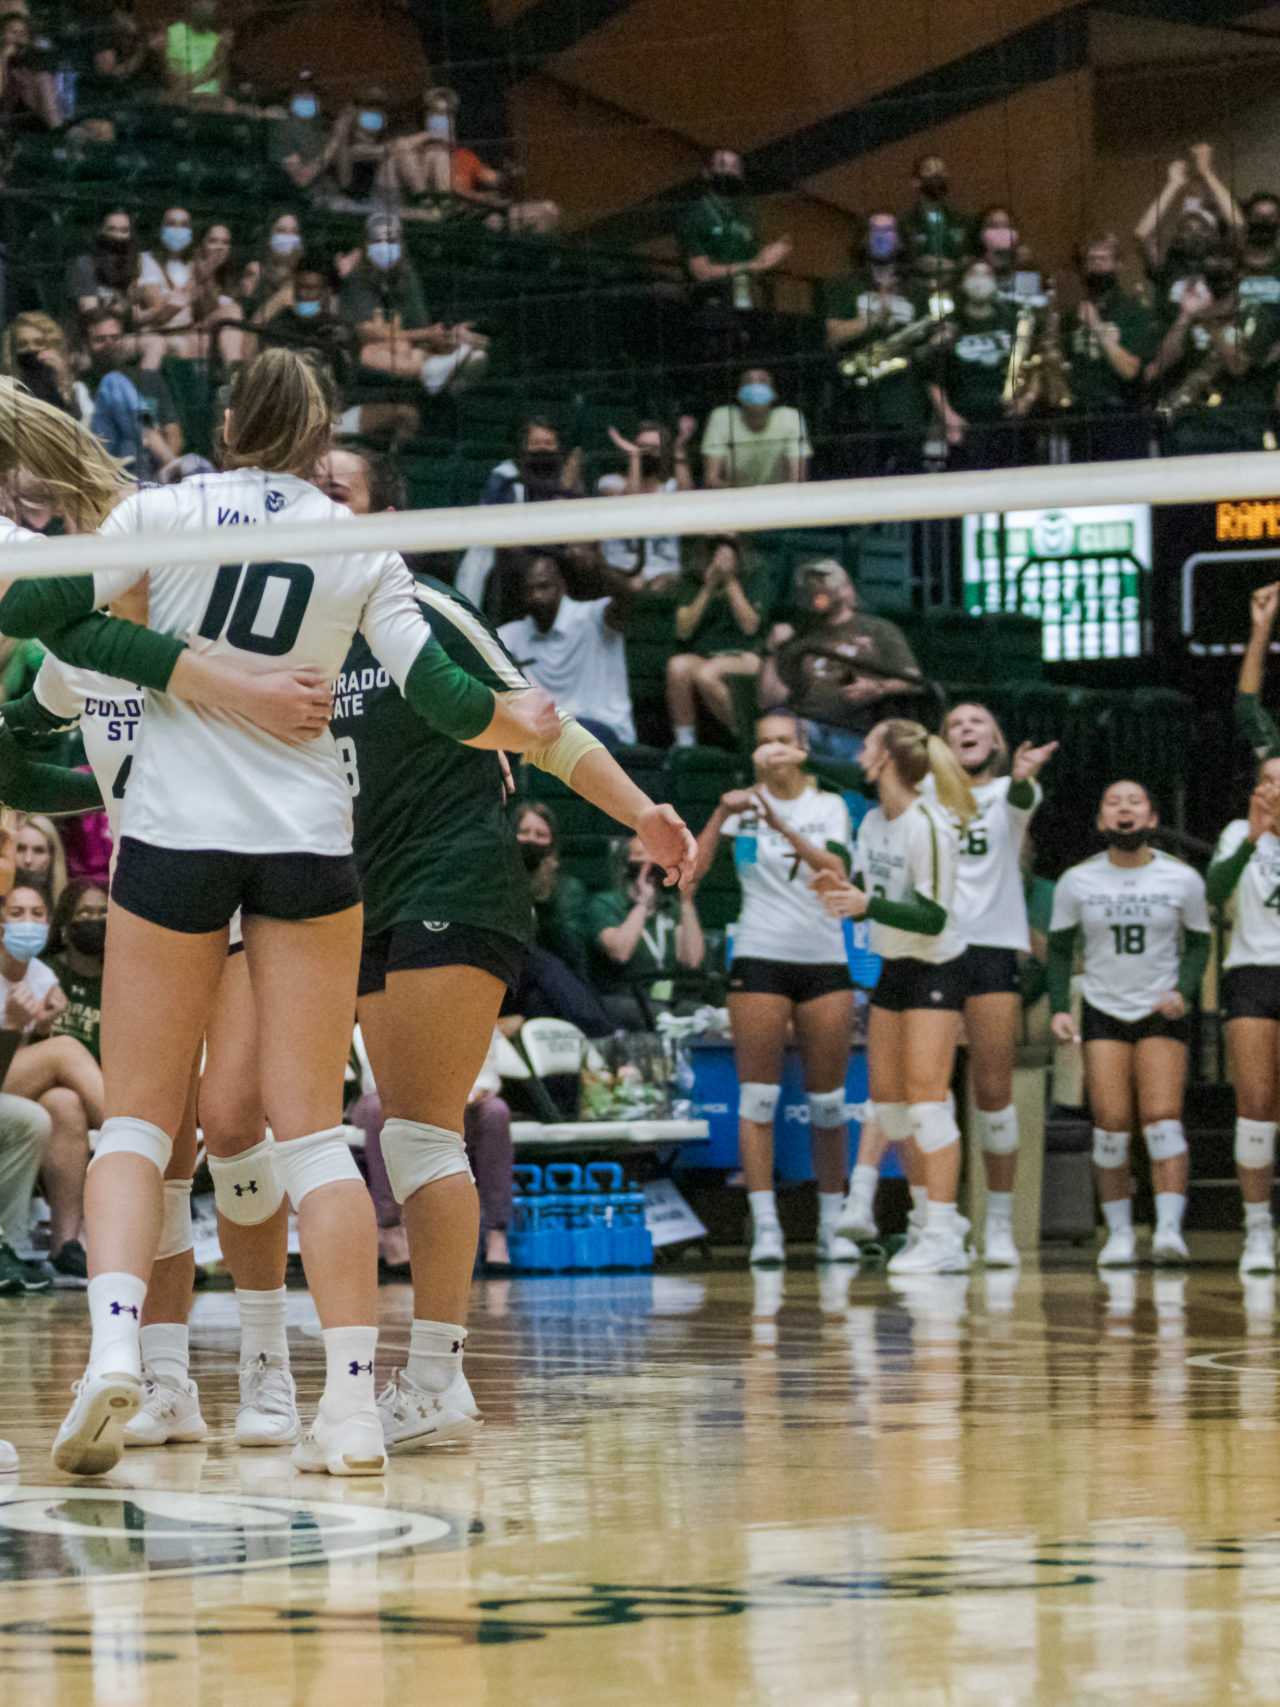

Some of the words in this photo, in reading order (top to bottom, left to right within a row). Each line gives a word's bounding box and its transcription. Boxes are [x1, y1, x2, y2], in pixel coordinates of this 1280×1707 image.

[198, 561, 315, 657] 10
[84, 697, 145, 718] COLO
[328, 694, 364, 720] ATE
[1110, 923, 1146, 955] 18
